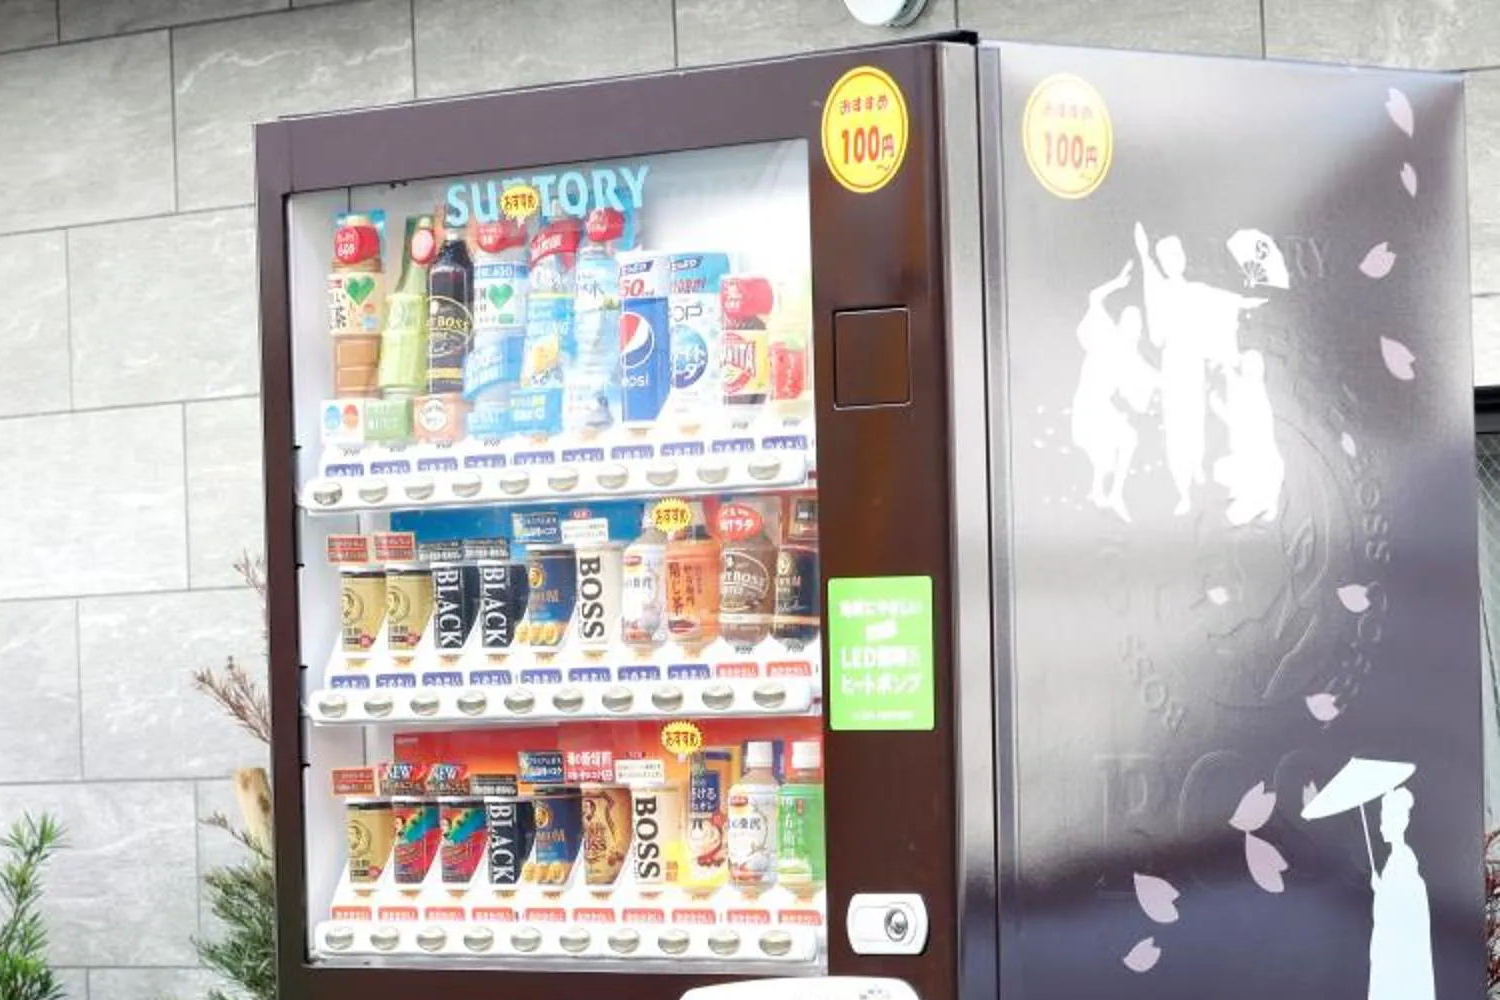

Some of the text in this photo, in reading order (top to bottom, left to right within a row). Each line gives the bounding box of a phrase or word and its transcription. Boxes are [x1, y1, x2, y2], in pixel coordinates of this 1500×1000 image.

[841, 124, 895, 165] 100円
[446, 164, 650, 228] SUTORY
[437, 567, 463, 646] BLACK
[483, 565, 508, 646] BLACK
[580, 556, 605, 639] BOSS
[488, 803, 515, 884] BLACK
[635, 795, 661, 879] BOSS
